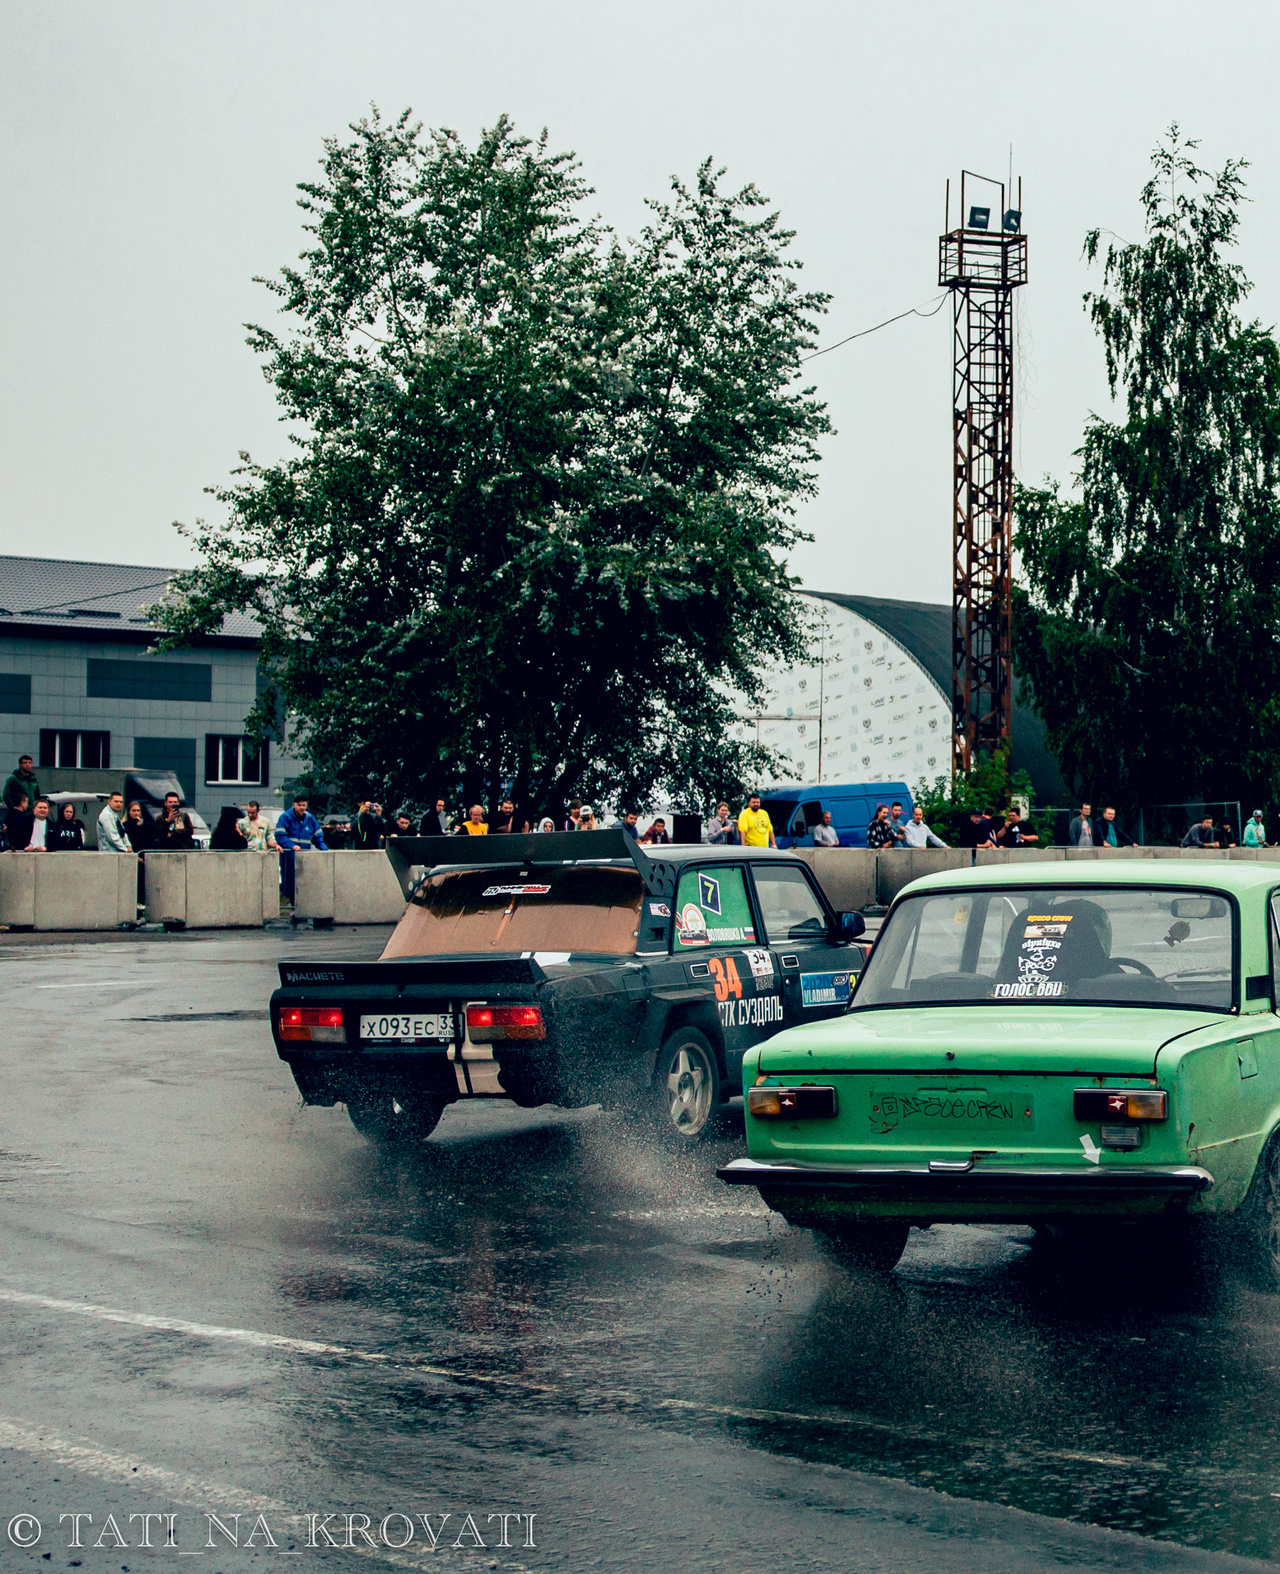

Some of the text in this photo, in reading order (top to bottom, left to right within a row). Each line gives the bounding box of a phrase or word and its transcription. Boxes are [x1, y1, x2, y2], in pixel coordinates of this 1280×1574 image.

[704, 881, 714, 903] 7
[753, 951, 766, 964] 34
[287, 970, 344, 982] MACHETE
[709, 957, 742, 1001] 34
[804, 988, 837, 1003] VLADIMIR
[995, 983, 1034, 998] ГОЛОС
[738, 996, 783, 1027] СУЗДАЛЬ
